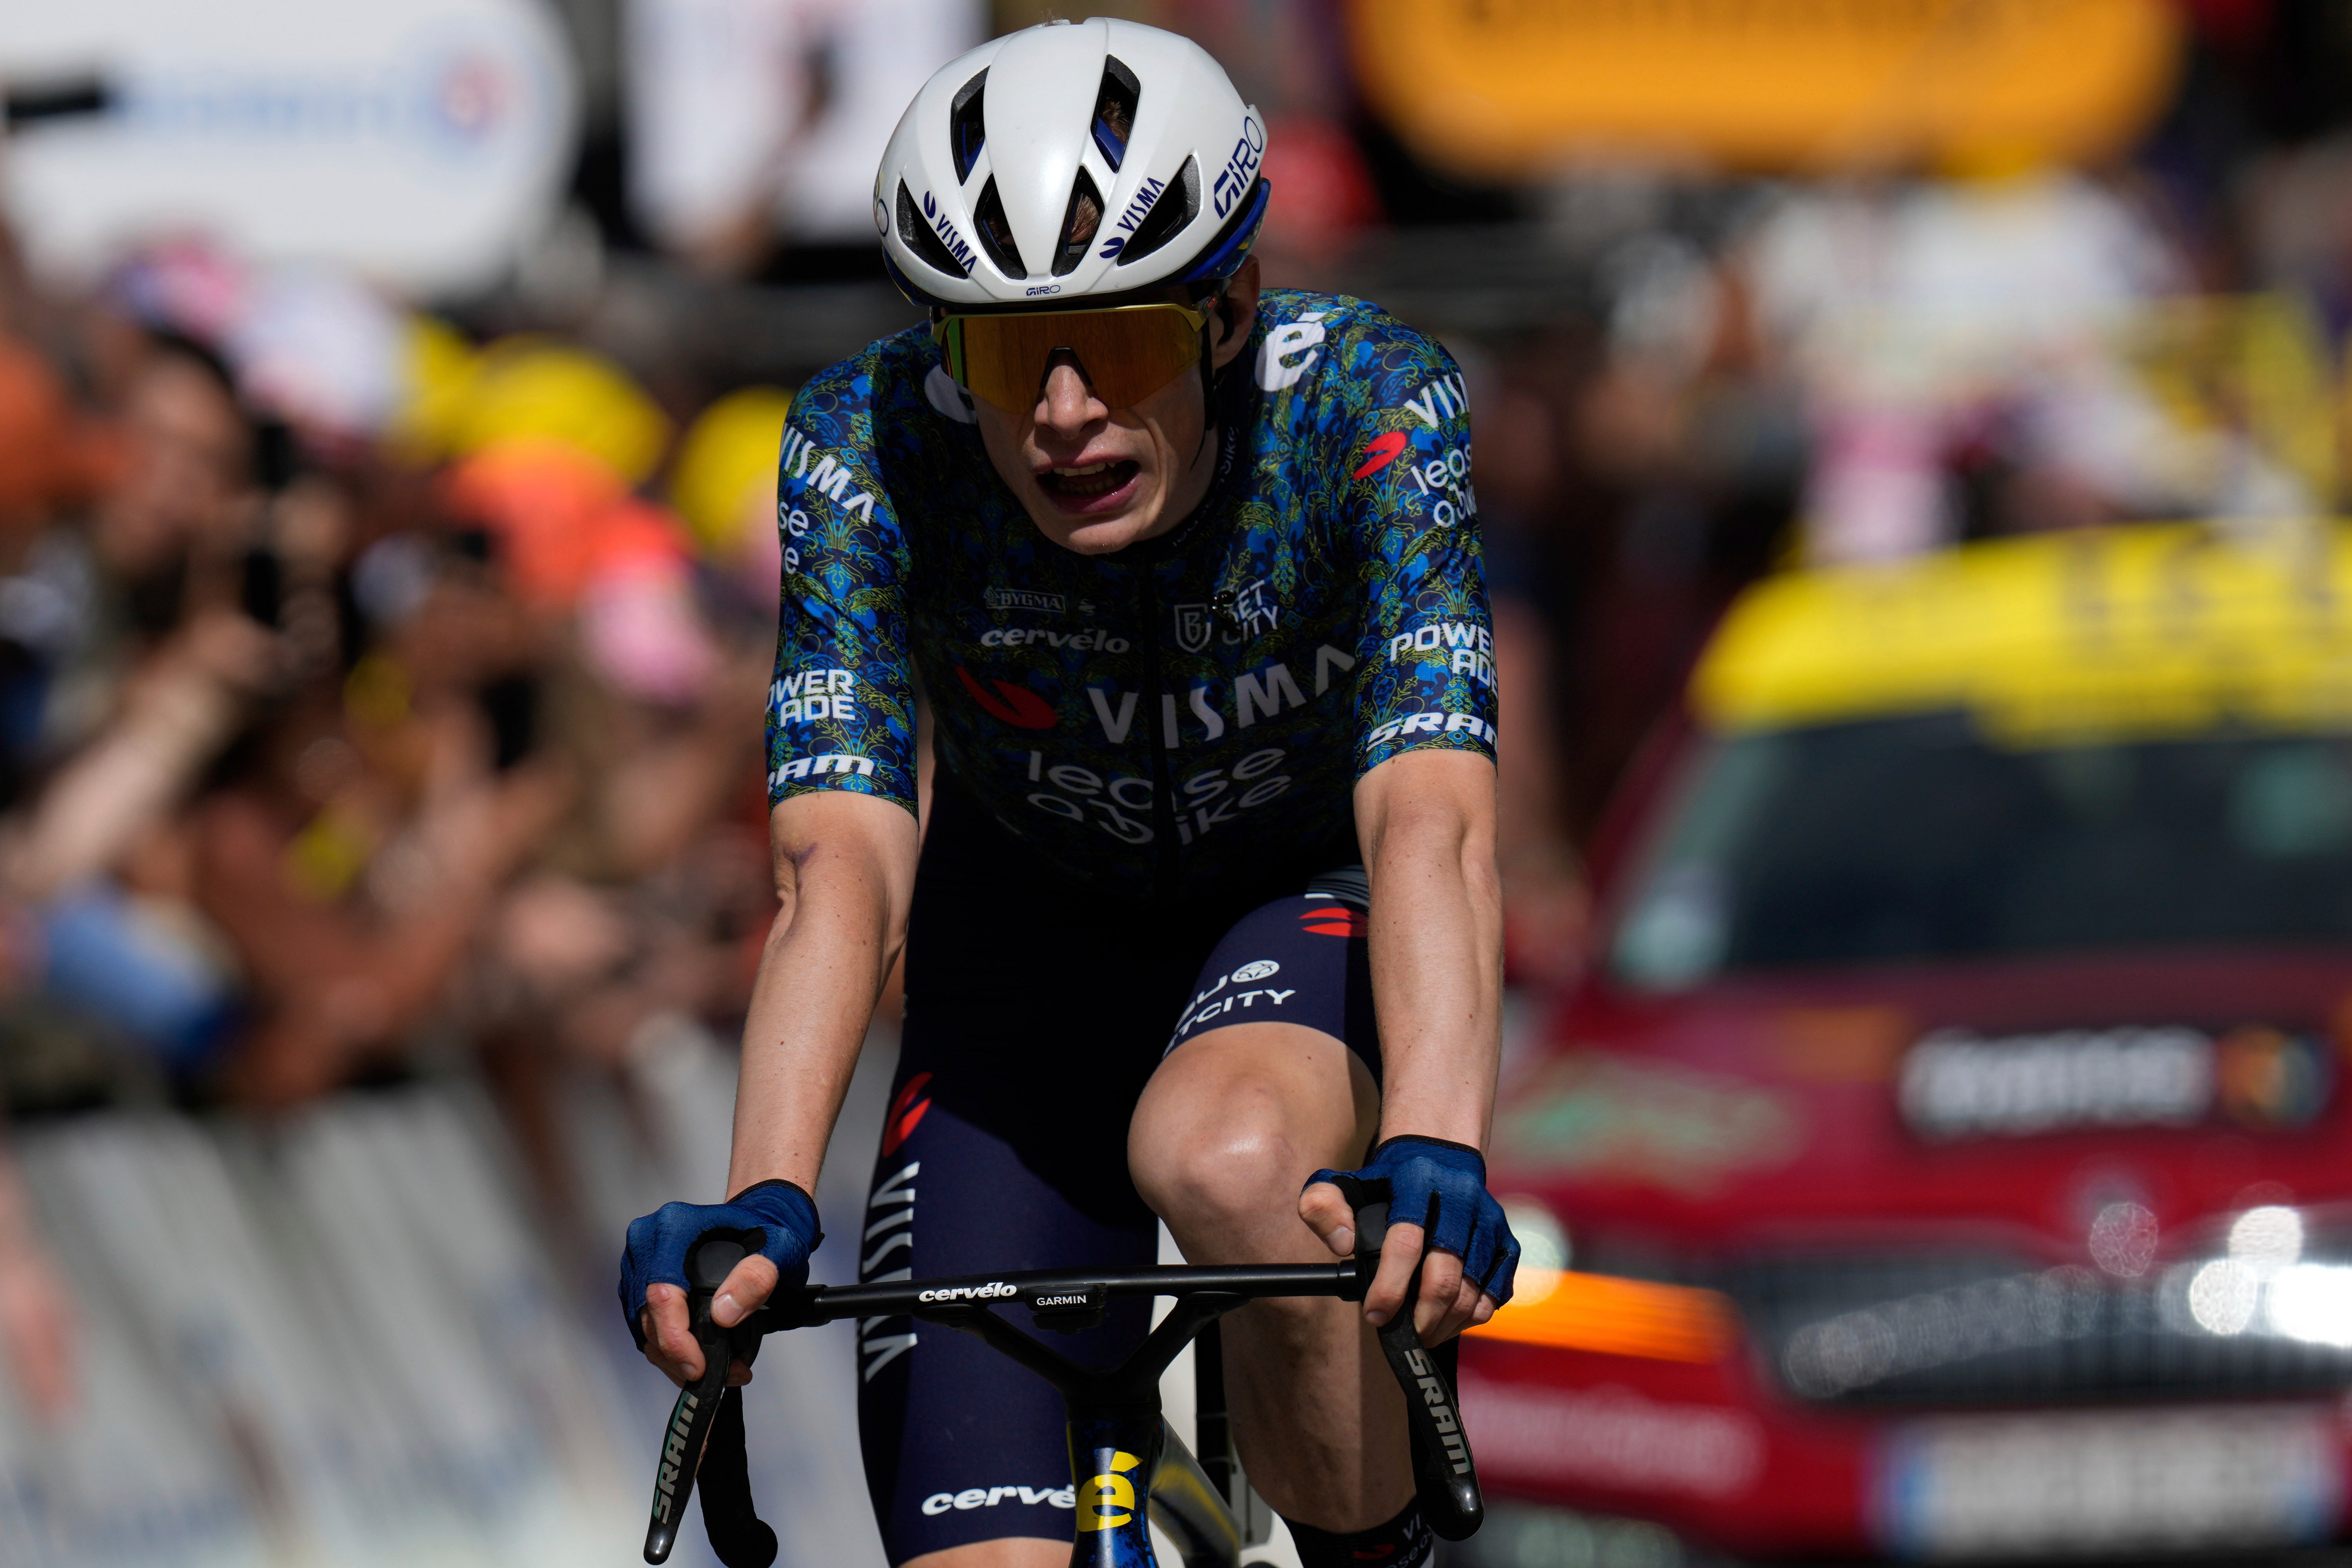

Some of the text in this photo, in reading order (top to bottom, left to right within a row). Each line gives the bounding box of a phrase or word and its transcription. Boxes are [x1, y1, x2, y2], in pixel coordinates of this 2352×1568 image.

[1214, 116, 1262, 219] GIRO
[1117, 177, 1165, 232] VISMA
[936, 213, 977, 274] VISMA
[1026, 285, 1060, 296] GIRO
[1410, 443, 1472, 495] leas
[1000, 593, 1062, 610] BYGMA
[980, 628, 1130, 653] cervélo
[1389, 622, 1497, 664] POWE
[765, 669, 854, 714] OWER
[780, 695, 856, 728] ADE
[1087, 644, 1356, 749] VISMA
[919, 1282, 1017, 1302] cervélo
[1036, 1295, 1087, 1305] GARMIN
[1404, 1348, 1471, 1474] SRAM
[653, 1390, 699, 1524] SRAM
[922, 1483, 1076, 1516] cervé
